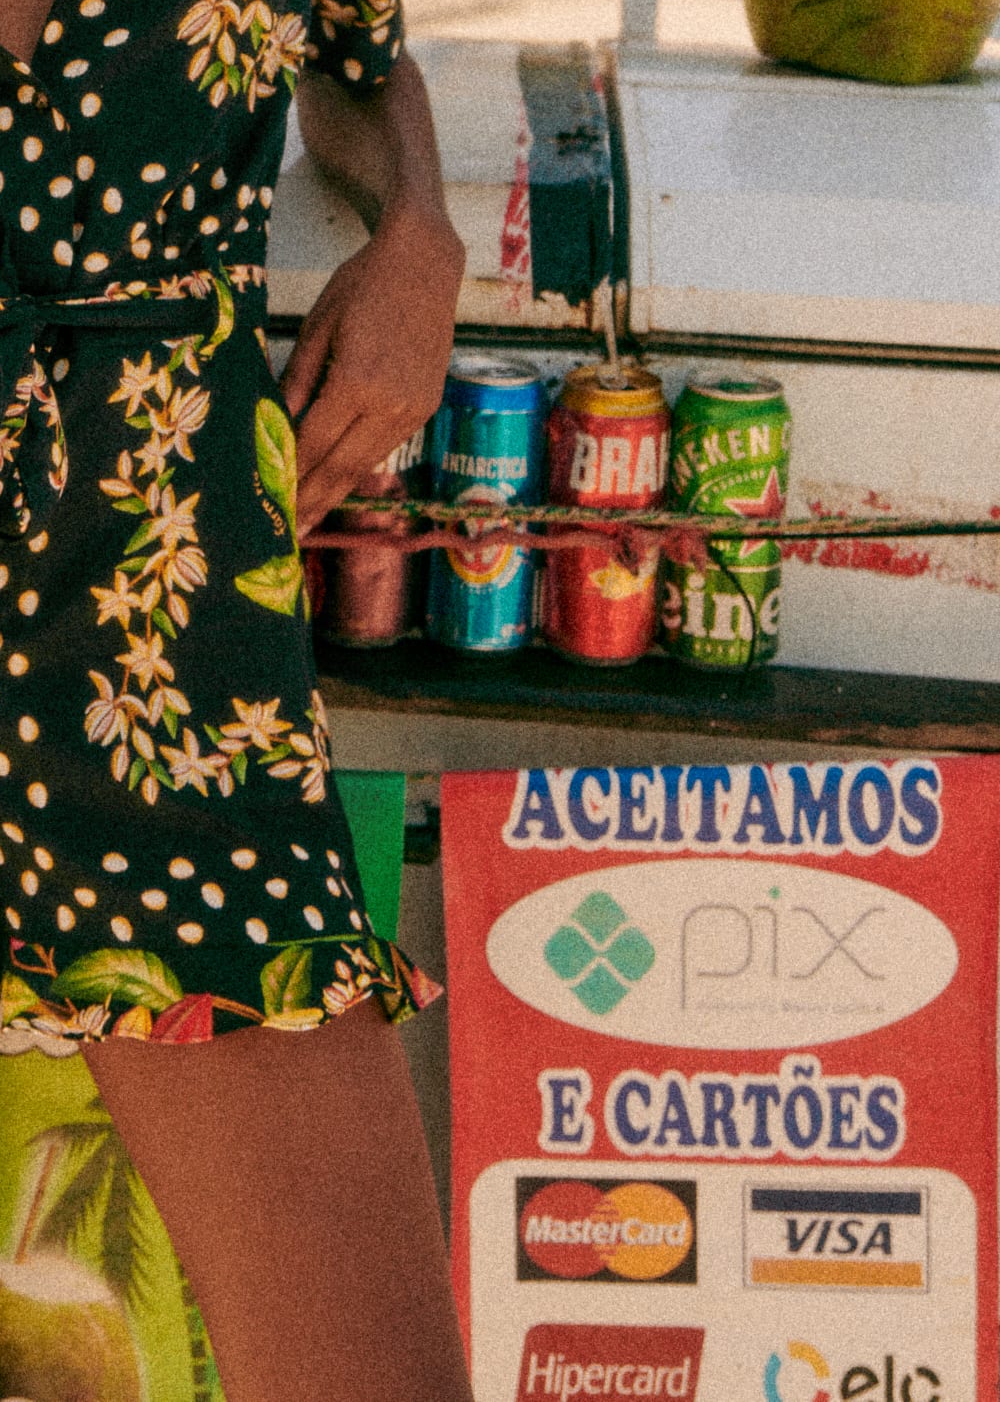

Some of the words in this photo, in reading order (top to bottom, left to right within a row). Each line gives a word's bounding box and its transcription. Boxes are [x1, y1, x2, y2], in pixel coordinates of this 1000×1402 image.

[442, 451, 528, 479] ANTARCTICA
[569, 429, 671, 494] BRA
[512, 764, 940, 847] ACEITAMOS
[681, 885, 886, 1012] pix
[548, 1078, 586, 1144] E
[612, 1063, 901, 1152] CARTÕES
[524, 1215, 687, 1247] MasterCard
[786, 1218, 893, 1256] VISA
[526, 1351, 691, 1402] Hipercard
